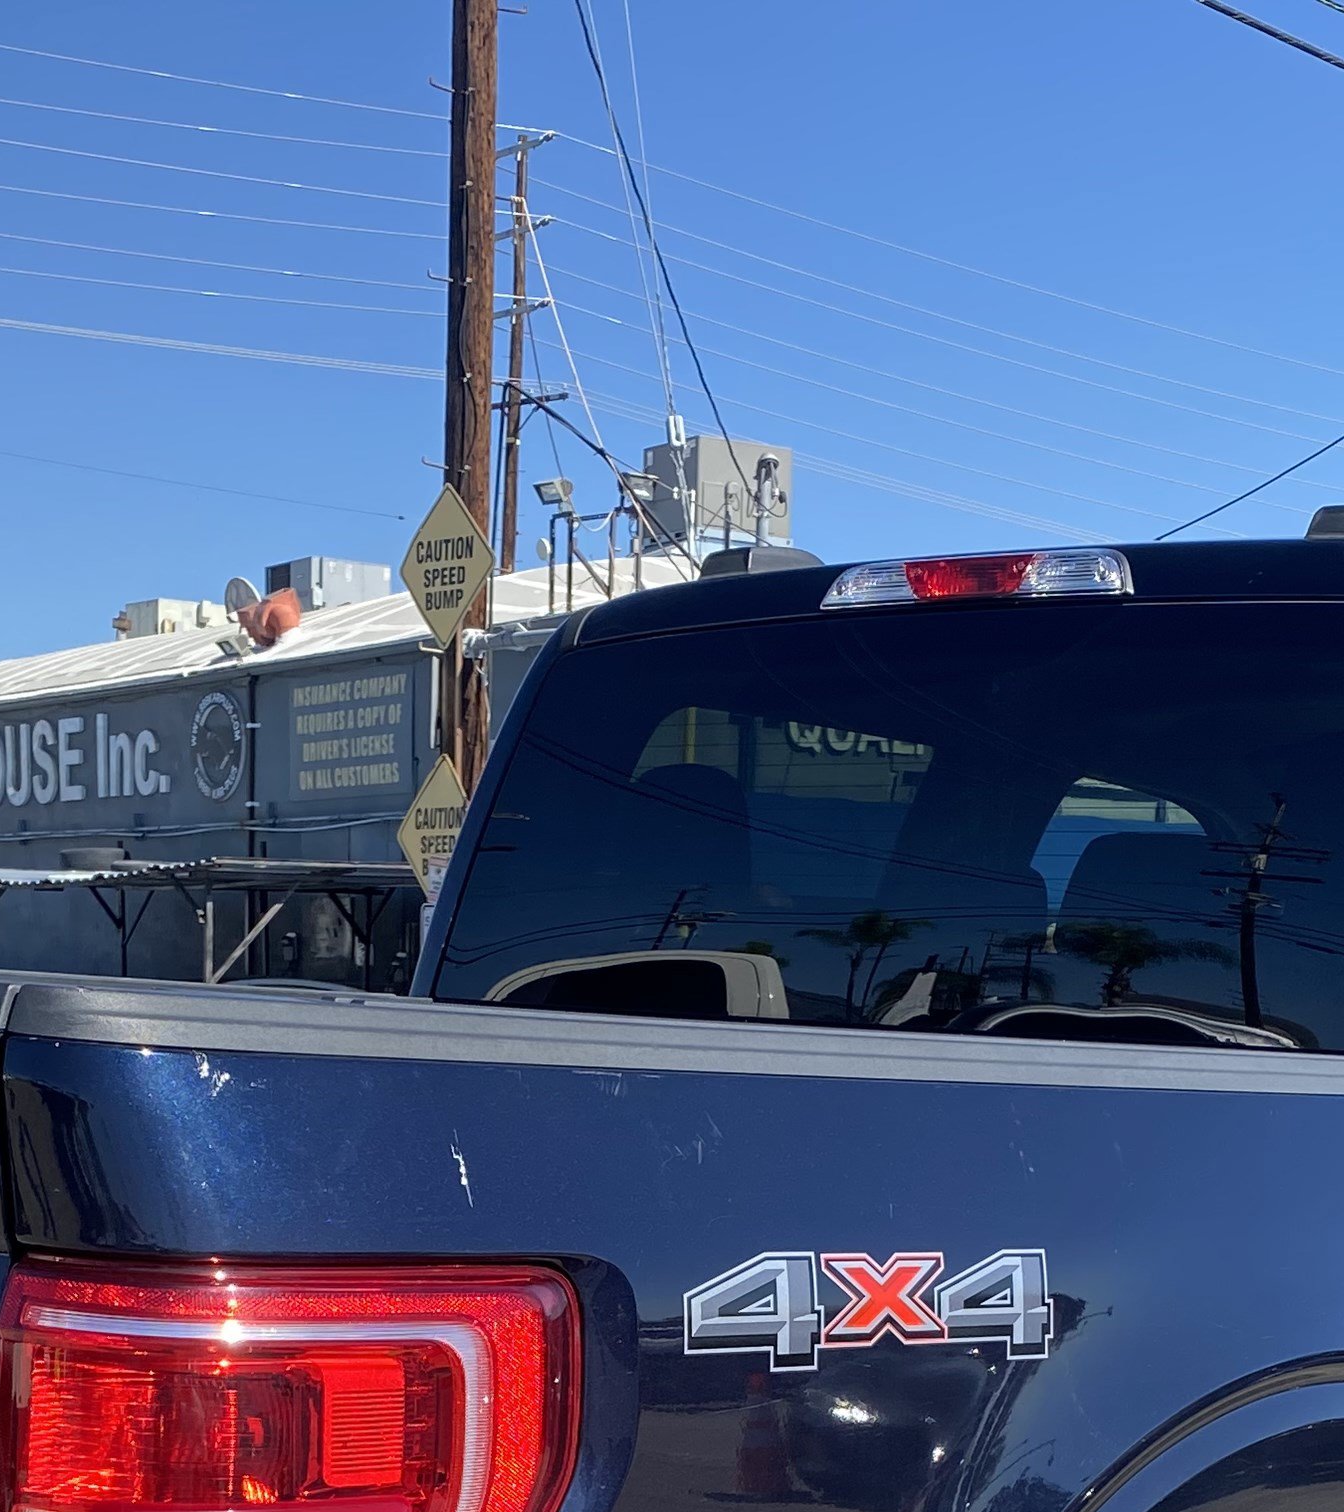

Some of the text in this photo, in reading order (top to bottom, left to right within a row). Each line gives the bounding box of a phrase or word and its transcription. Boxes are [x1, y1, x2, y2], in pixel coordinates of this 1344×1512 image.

[416, 535, 475, 564] CAUTION
[423, 565, 466, 588] SPEED
[425, 588, 464, 611] BUMP
[293, 673, 407, 707] INSURANCE COMPANY
[296, 703, 403, 735] REQUIRES A COPY OF
[96, 713, 171, 798] Inc.
[302, 733, 395, 762] DRIVER'S LICENSE
[299, 762, 400, 791] ON ALL CUSTOMERS
[415, 806, 467, 830] CAUTION
[420, 835, 457, 854] SPEED
